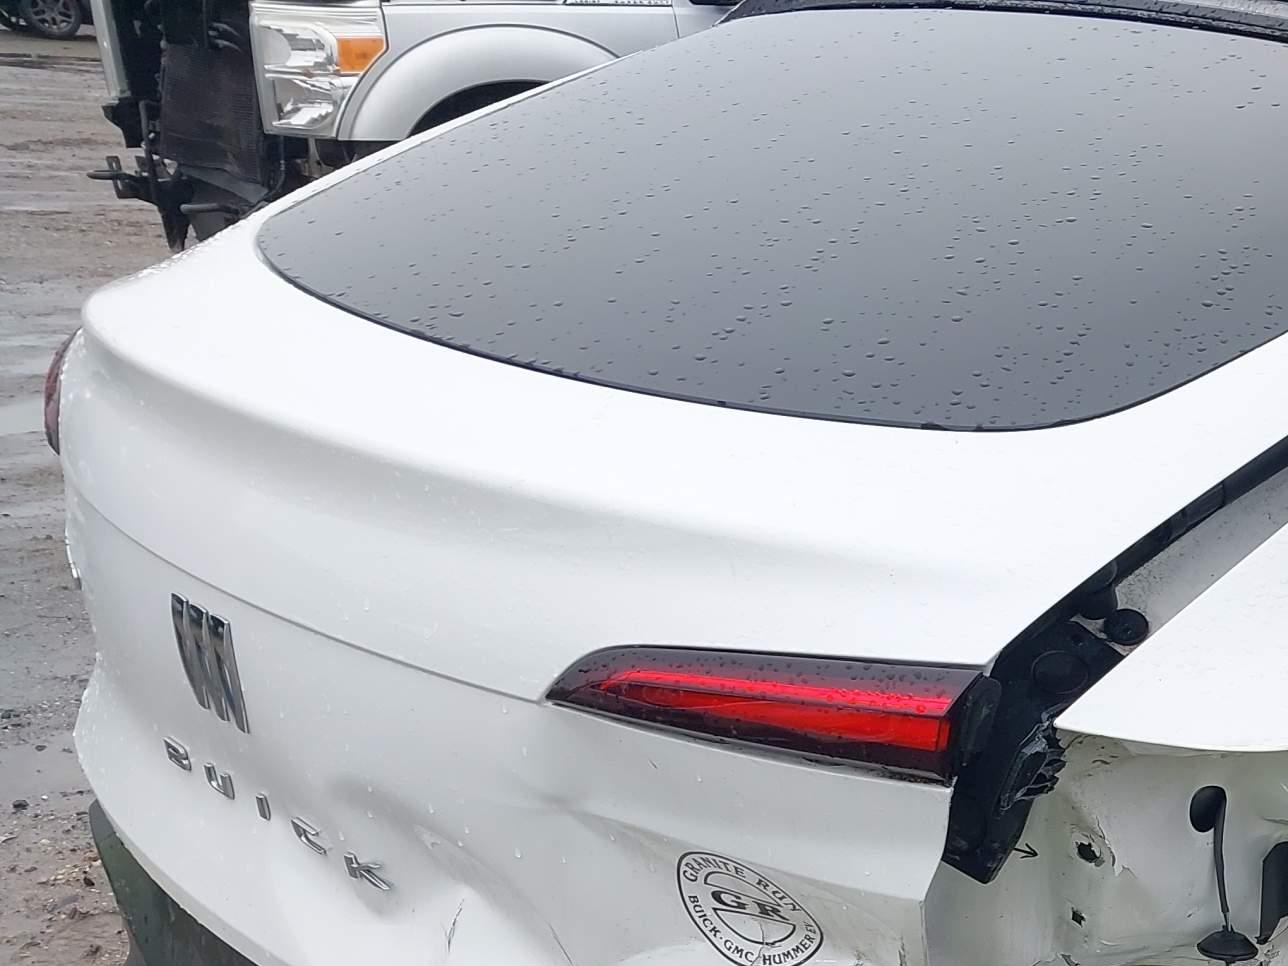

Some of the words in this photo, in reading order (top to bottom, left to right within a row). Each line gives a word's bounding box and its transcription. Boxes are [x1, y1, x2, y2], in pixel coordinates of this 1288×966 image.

[163, 736, 393, 891] BUICK
[682, 856, 746, 882] GRANITE
[756, 878, 801, 912] RUN
[711, 890, 790, 921] GR
[762, 934, 816, 966] HUMMER
